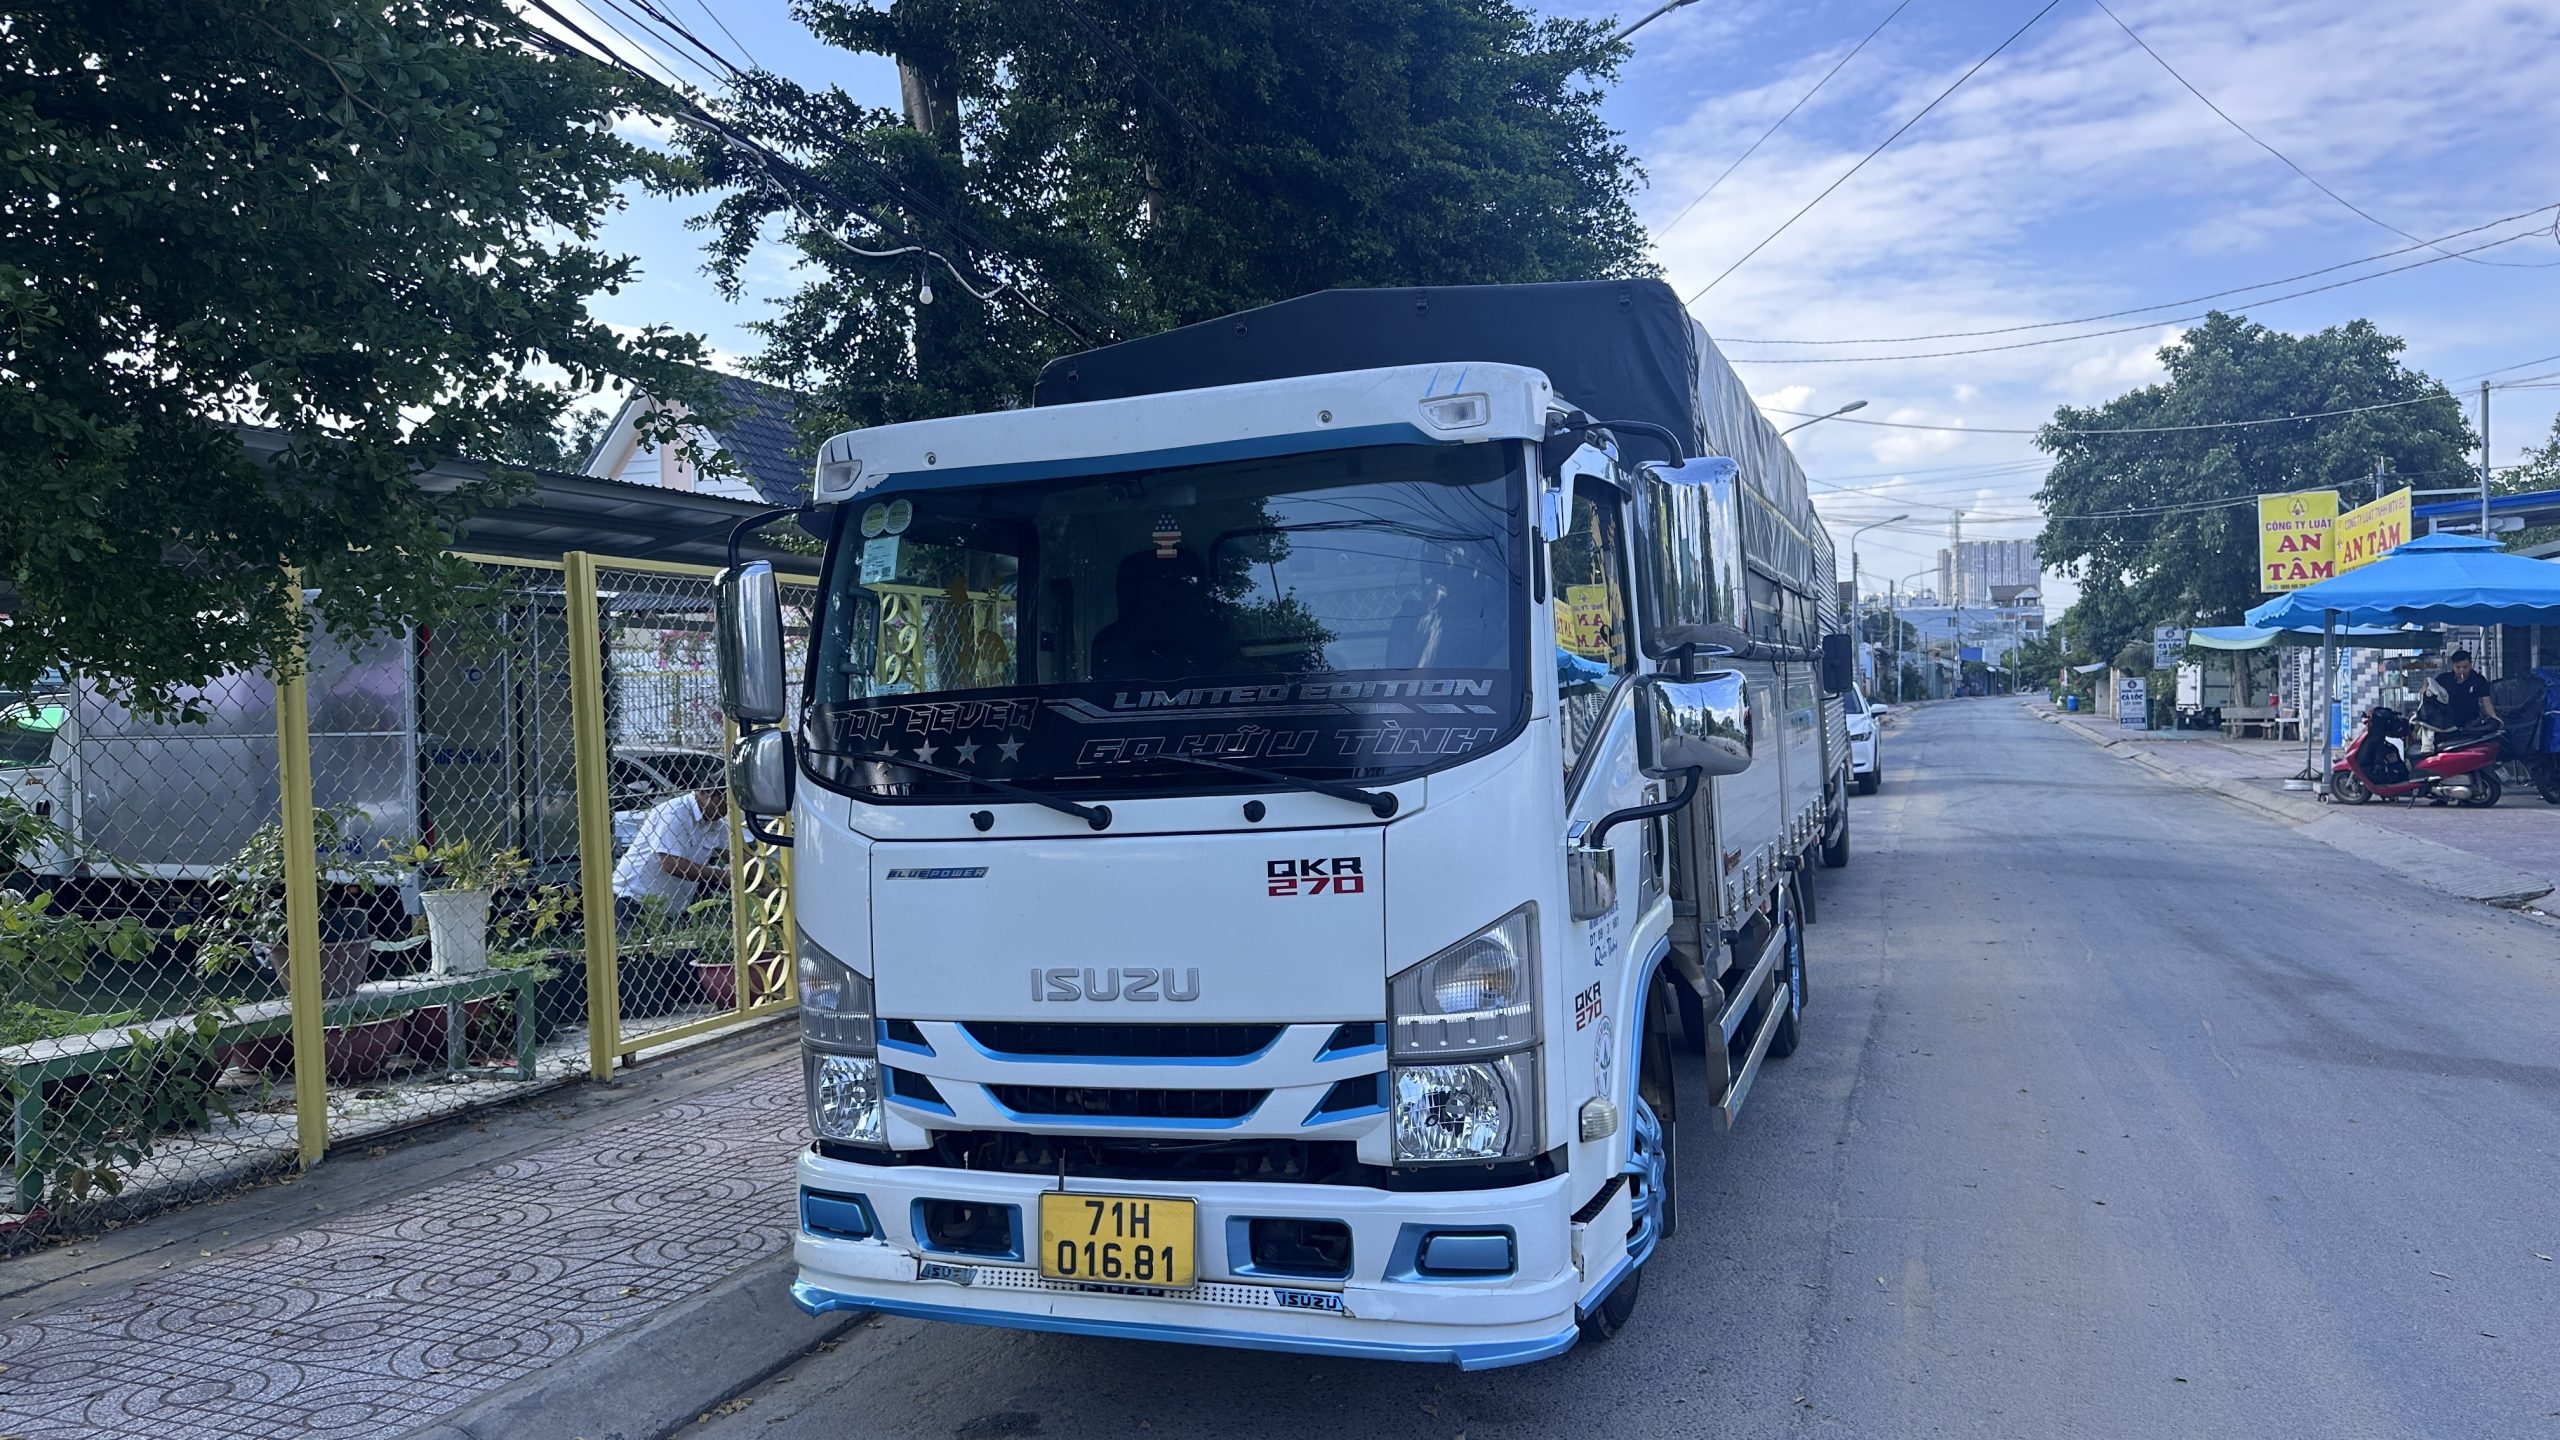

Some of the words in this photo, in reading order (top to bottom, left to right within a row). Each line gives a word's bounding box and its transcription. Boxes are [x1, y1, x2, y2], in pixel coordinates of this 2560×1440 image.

[2265, 520, 2292, 532] CÔNG
[2295, 520, 2306, 530] TY
[2277, 533, 2322, 553] AN
[2343, 535, 2364, 564] AN
[2367, 520, 2401, 556] TÂM
[2267, 556, 2335, 581] TÂM
[1113, 686, 1290, 709] LIMITED
[1299, 679, 1494, 701] EDITION
[826, 706, 898, 743] TOP
[1267, 857, 1363, 877] QKR
[1268, 876, 1364, 896] 270
[1031, 967, 1200, 1002] ISUZU
[1575, 980, 1601, 1013] QKR
[1576, 998, 1602, 1032] 270
[1084, 1201, 1150, 1239] 71H
[1057, 1240, 1173, 1282] 016.81
[1281, 1294, 1338, 1309] ISUZU
